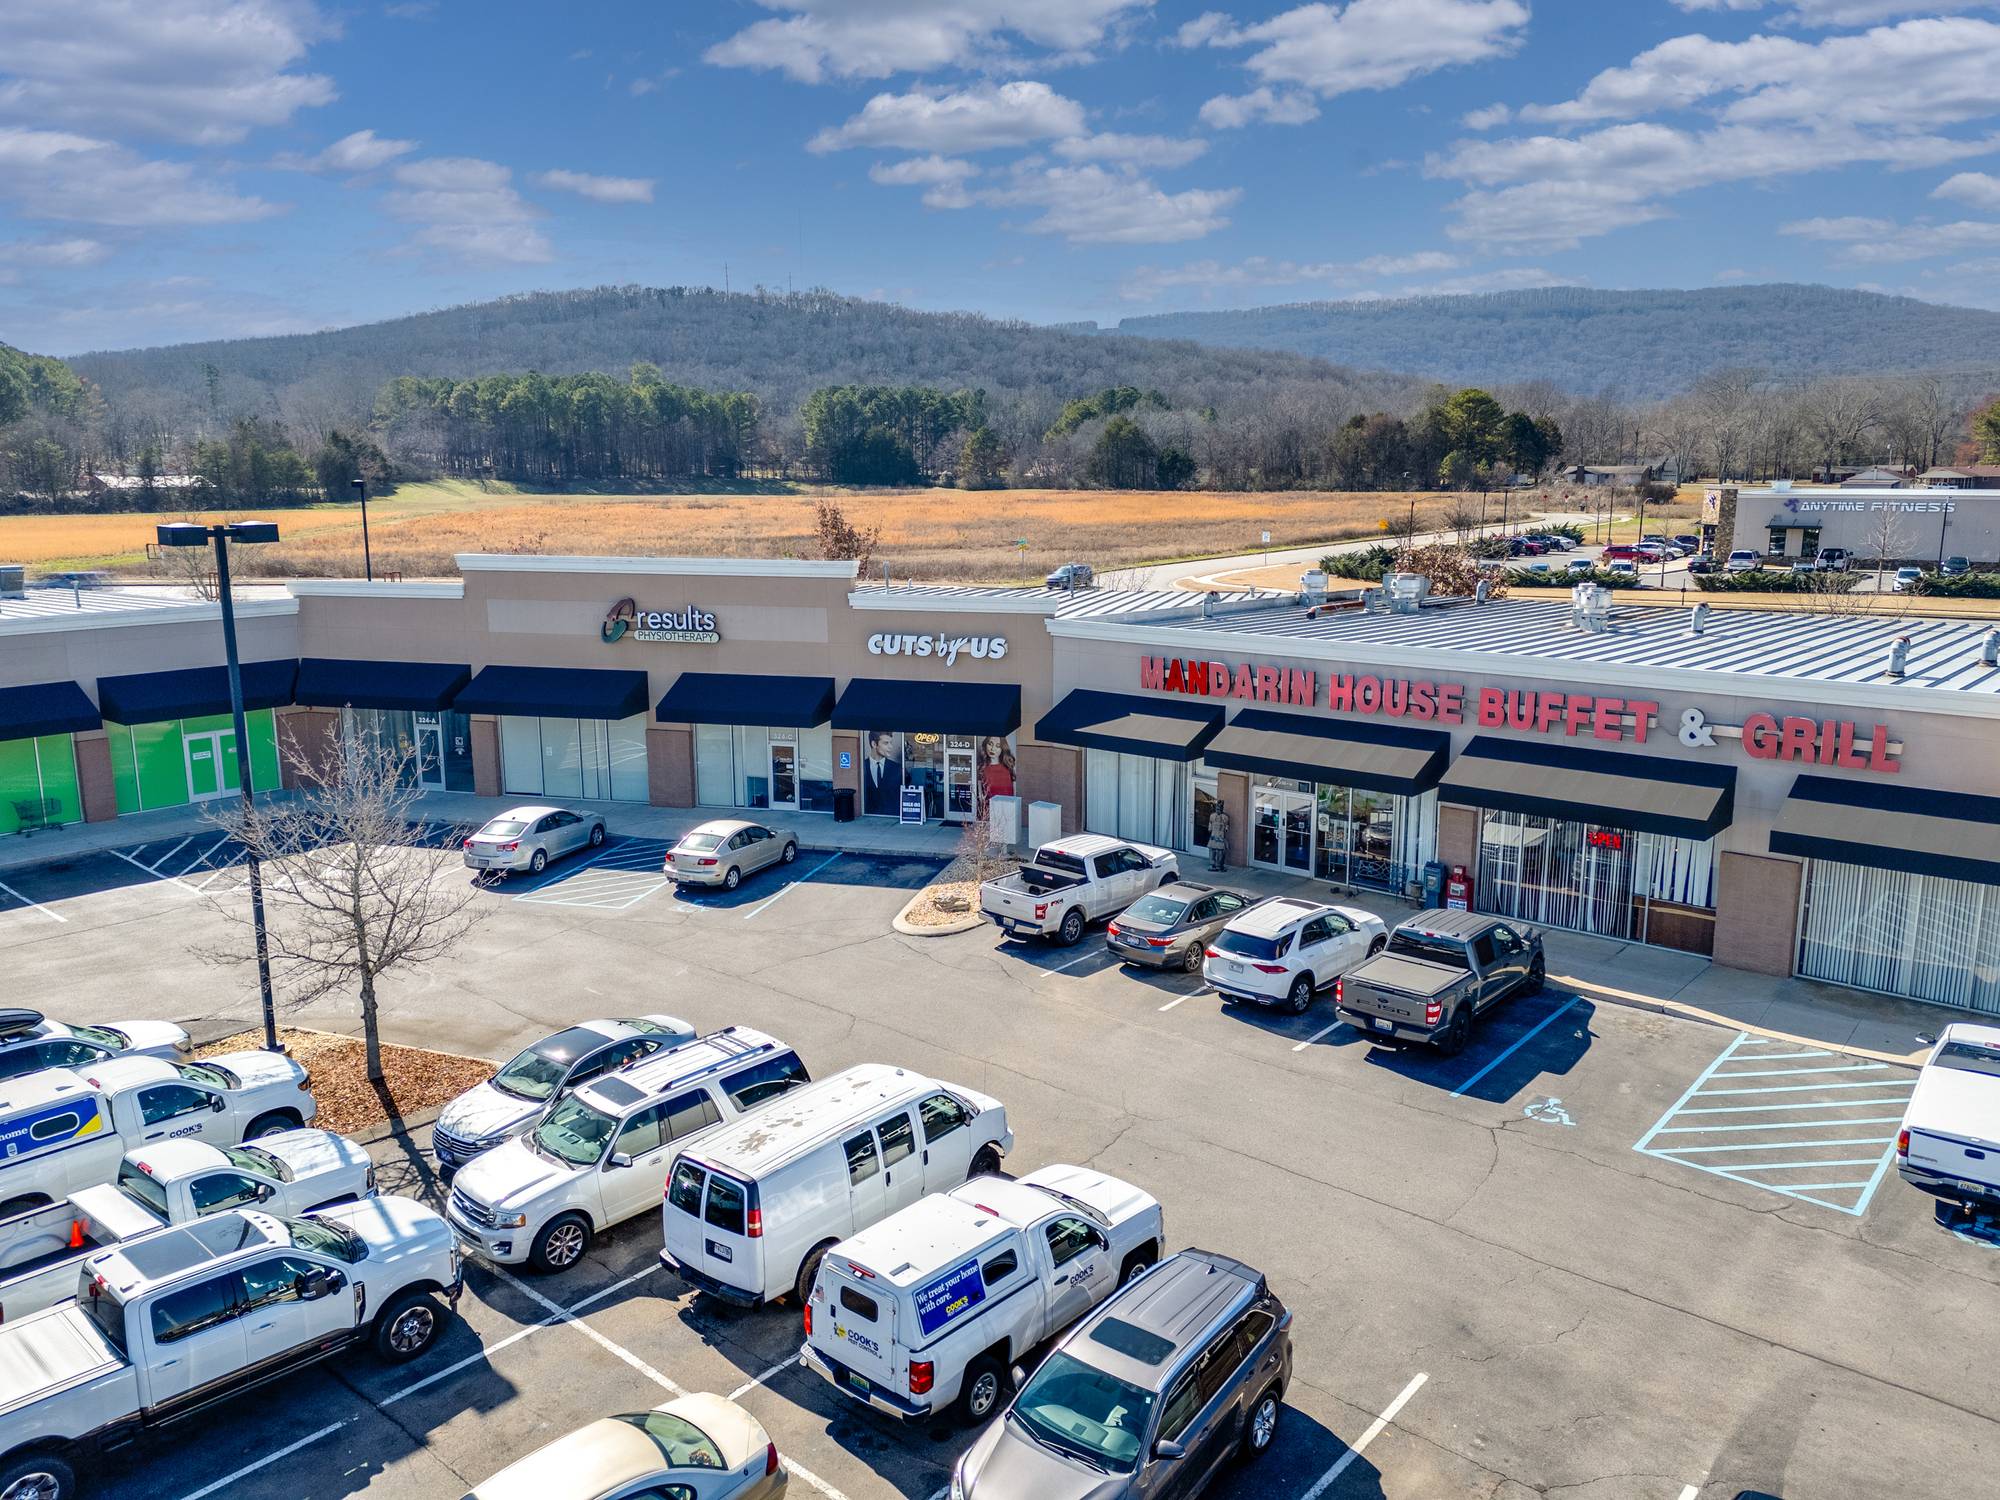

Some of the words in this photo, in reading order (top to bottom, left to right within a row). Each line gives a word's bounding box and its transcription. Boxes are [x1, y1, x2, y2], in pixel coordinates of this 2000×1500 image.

[1800, 501, 1865, 512] ANYTIME
[1870, 501, 1956, 513] FITNESS
[636, 605, 716, 631] results
[637, 630, 715, 642] PHYSIOTHERAPY
[867, 633, 933, 657] CUTS
[937, 632, 969, 667] by
[970, 637, 1007, 660] US
[1140, 655, 1317, 707] MANDARIN
[1328, 672, 1465, 726] HOUSE
[1477, 686, 1659, 744] BUFFET
[1678, 707, 1719, 748] &
[1740, 711, 1901, 774] GRILL
[916, 732, 937, 744] OPEN
[169, 1122, 203, 1139] COOK'S
[916, 1292, 928, 1305] We
[928, 1283, 945, 1299] treat
[944, 1275, 961, 1291] your
[960, 1264, 979, 1280] home
[1070, 1264, 1094, 1285] COOK'S
[919, 1300, 936, 1316] with
[936, 1292, 952, 1306] care.
[945, 1295, 969, 1313] COOK'S
[847, 1328, 879, 1352] COOK'S
[847, 1337, 858, 1346] PEST
[858, 1343, 879, 1357] CONTROL
